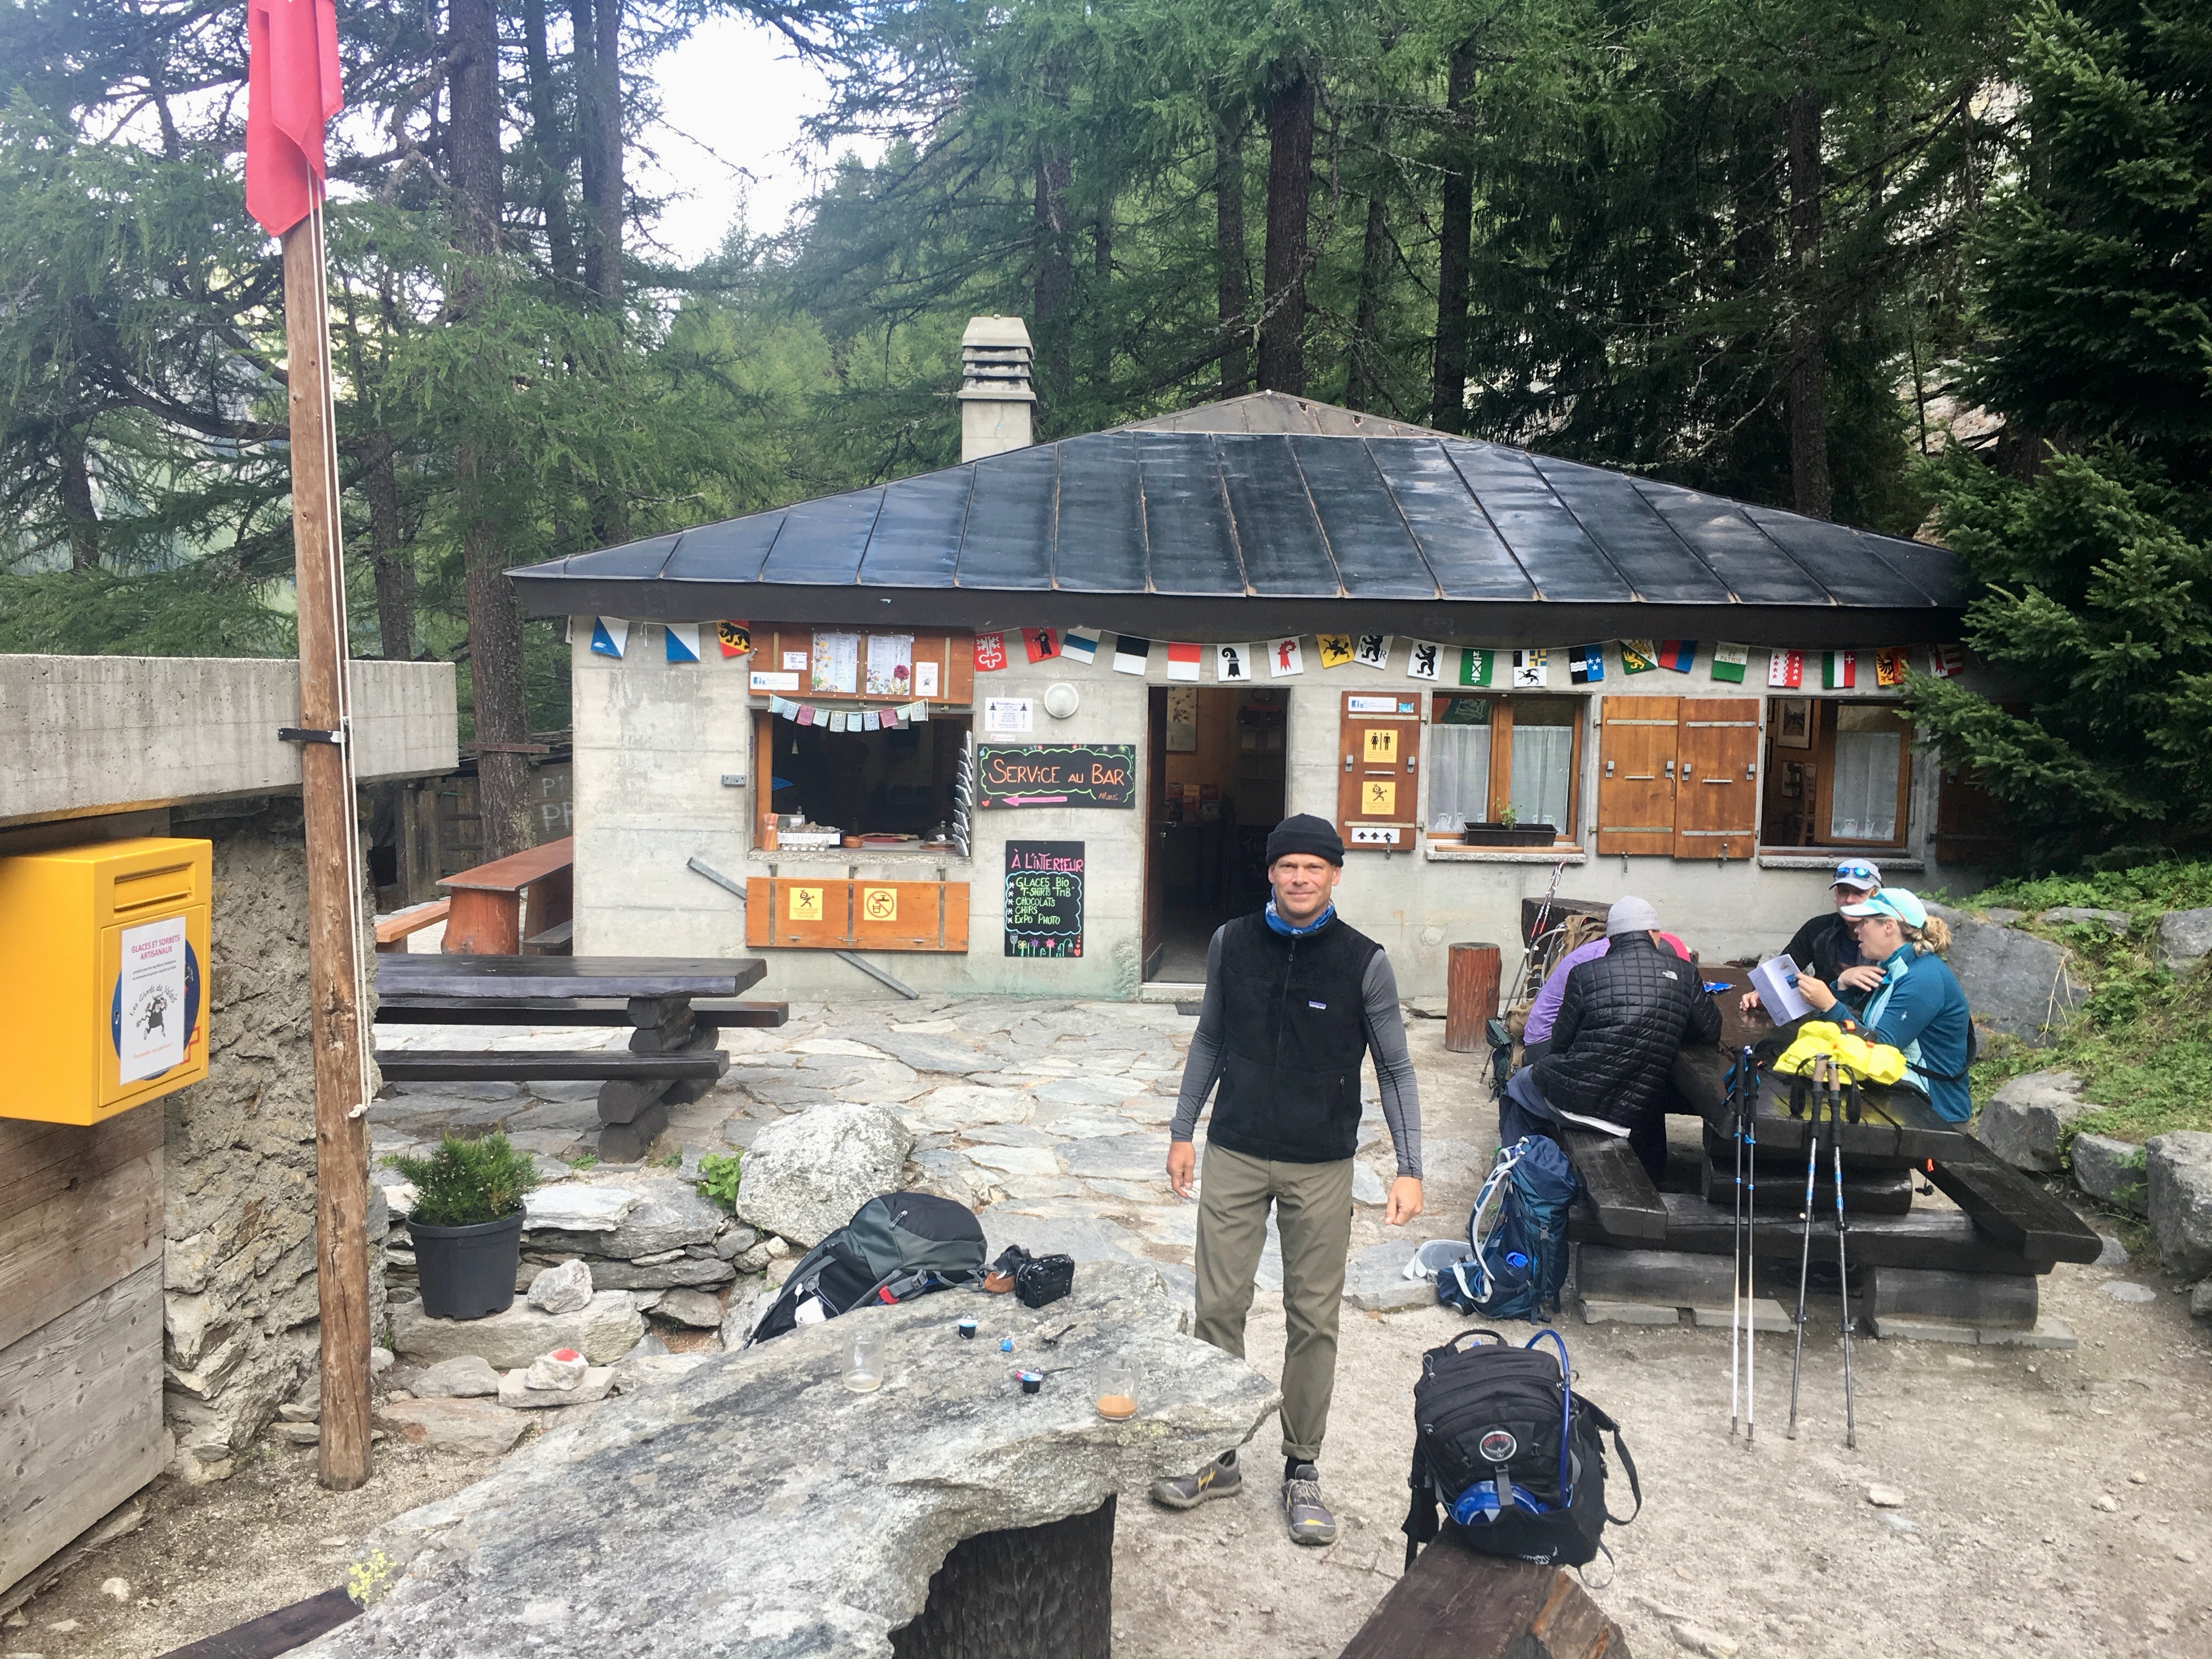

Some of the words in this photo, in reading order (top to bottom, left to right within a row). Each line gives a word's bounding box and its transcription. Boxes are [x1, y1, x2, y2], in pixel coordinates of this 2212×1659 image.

[1379, 650, 1387, 659] R
[1092, 763, 1125, 786] BAR
[792, 834, 817, 842] TOUCHER
[1011, 848, 1021, 868] À
[1015, 877, 1050, 888] GLACES
[1015, 896, 1056, 907] CHOCOLATS
[1038, 913, 1060, 925] PHOTO
[131, 942, 151, 953] GLACES
[151, 940, 158, 949] ET
[159, 934, 180, 946] SORBETS
[140, 945, 173, 961] ARTISANAUX
[129, 1002, 139, 1016] Les
[165, 985, 177, 1003] Valais
